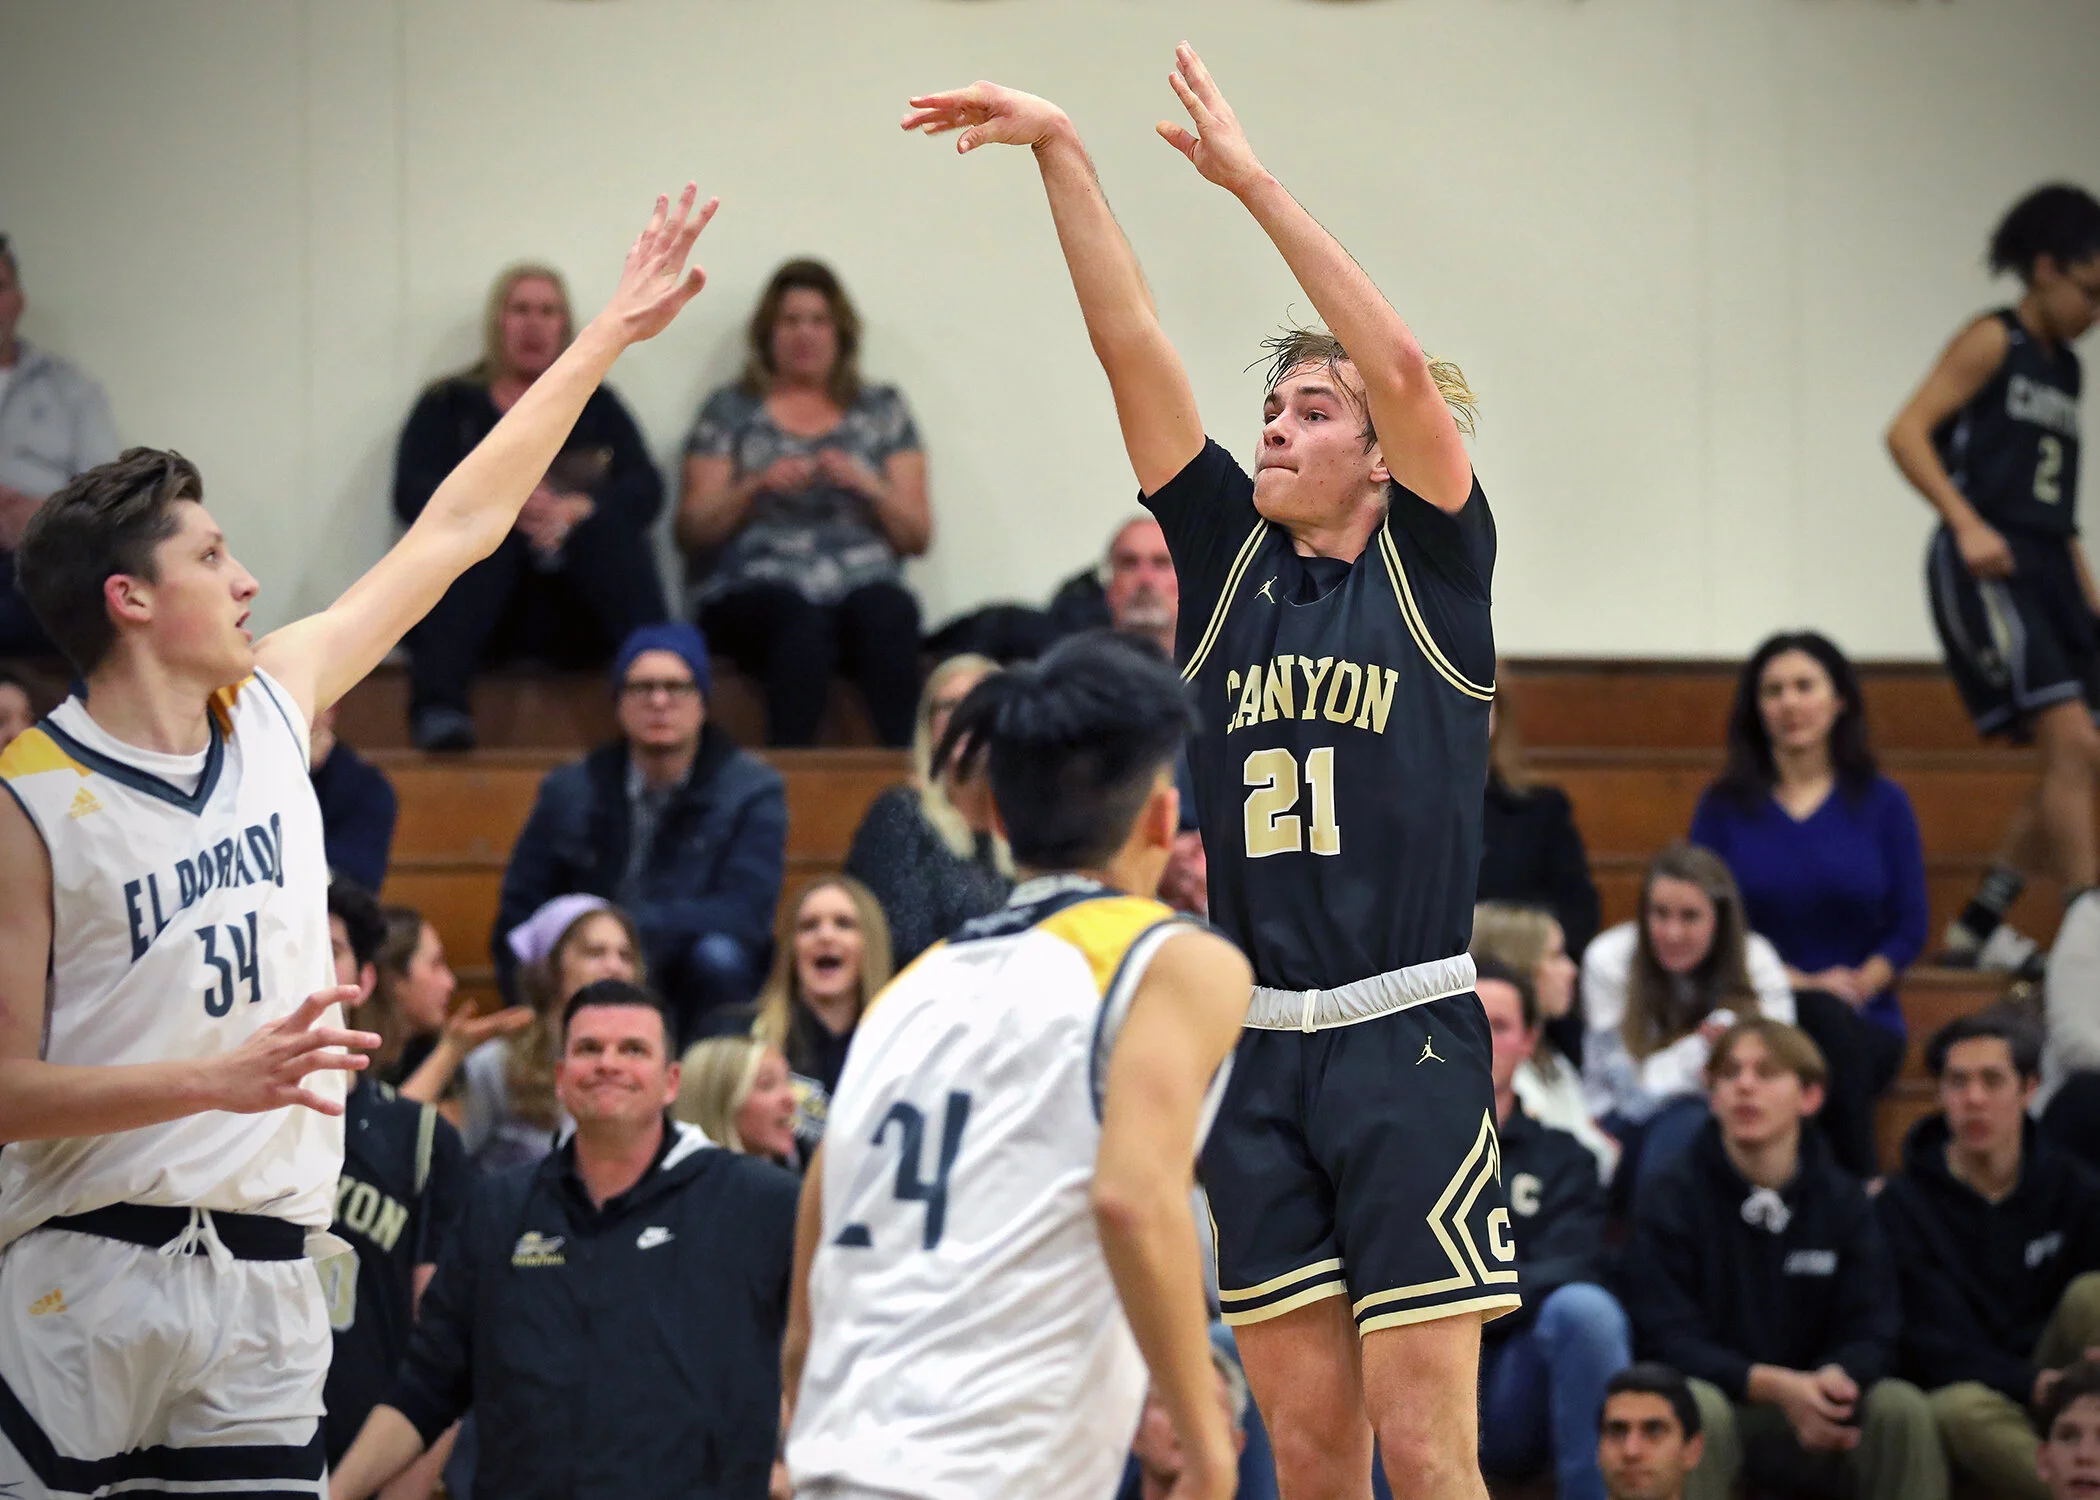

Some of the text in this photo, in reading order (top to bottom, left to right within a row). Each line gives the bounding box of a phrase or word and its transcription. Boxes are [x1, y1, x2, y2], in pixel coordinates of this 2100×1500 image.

[1227, 653, 1399, 735] CANYON
[1243, 745, 1341, 858] 21
[123, 872, 171, 965] EL
[195, 910, 262, 1018] 34
[1486, 1207, 1516, 1262] C
